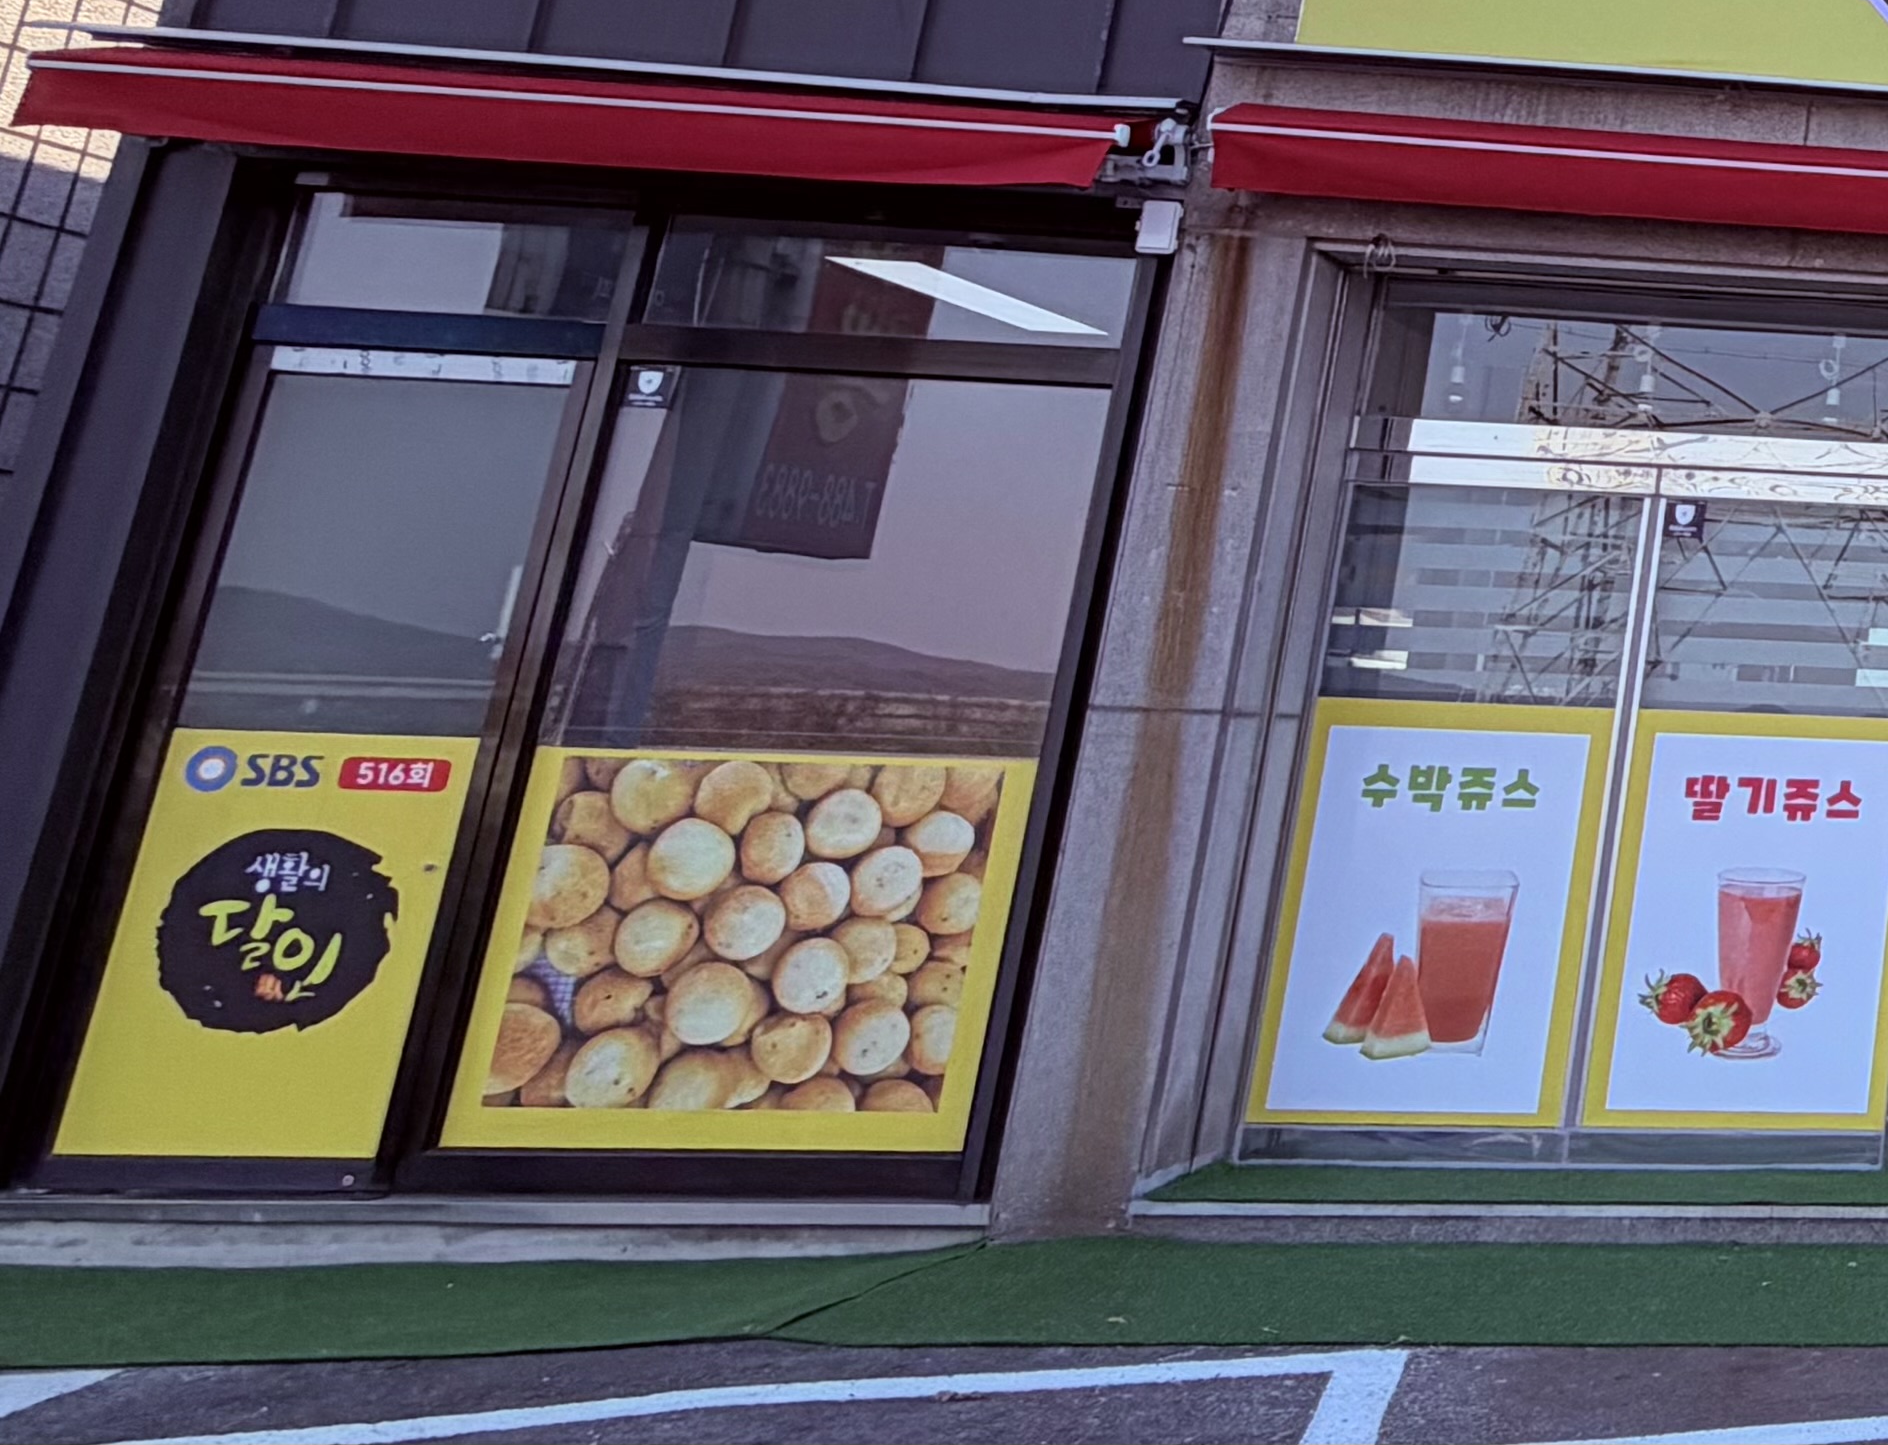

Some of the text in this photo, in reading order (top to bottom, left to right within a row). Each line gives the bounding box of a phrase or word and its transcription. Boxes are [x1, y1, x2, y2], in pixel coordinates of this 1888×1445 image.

[241, 753, 325, 788] SBS
[355, 760, 435, 788] 516회
[1360, 762, 1541, 812] 수박쥬스
[1684, 774, 1863, 822] 딸기쥬스
[245, 851, 332, 894] 생활의
[199, 893, 343, 1002] 달인
